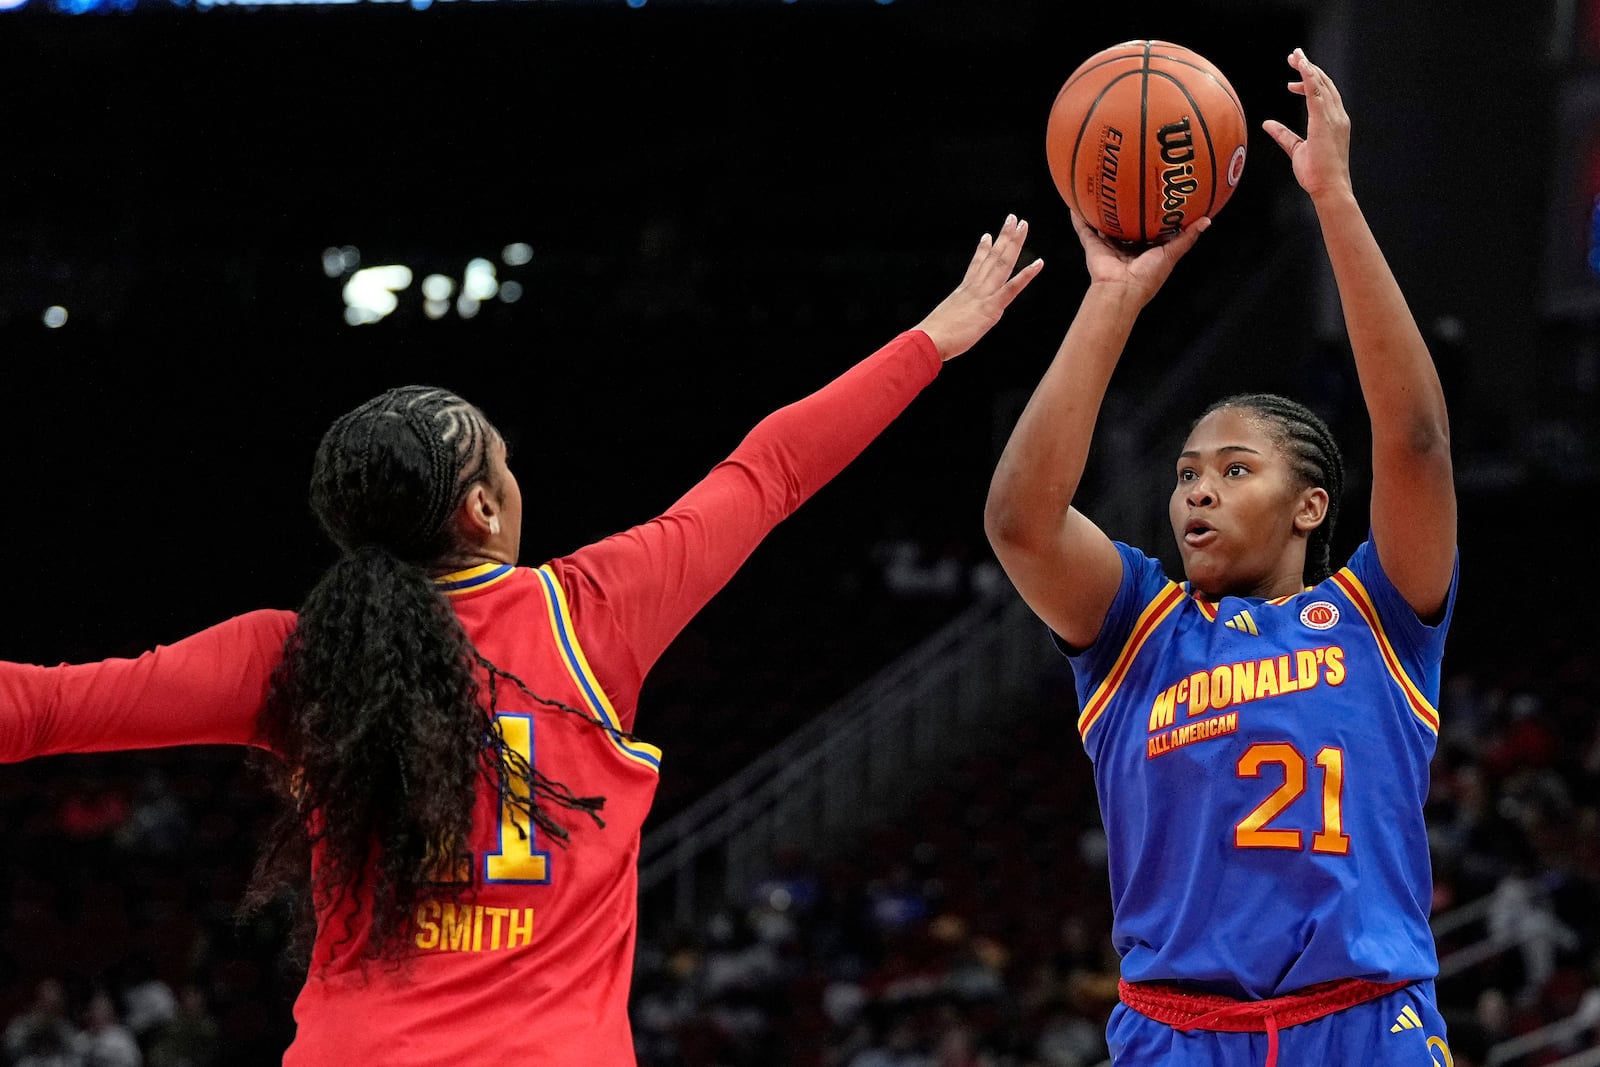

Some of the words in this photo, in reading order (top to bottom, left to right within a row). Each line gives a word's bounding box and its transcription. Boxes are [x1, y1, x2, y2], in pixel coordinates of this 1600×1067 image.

[1102, 127, 1123, 234] EVOLUTION
[1157, 116, 1198, 235] Wilson
[1147, 732, 1171, 759] ALL
[1170, 711, 1238, 748] AMERICAN
[1234, 742, 1350, 854] 21
[415, 901, 534, 952] SMITH
